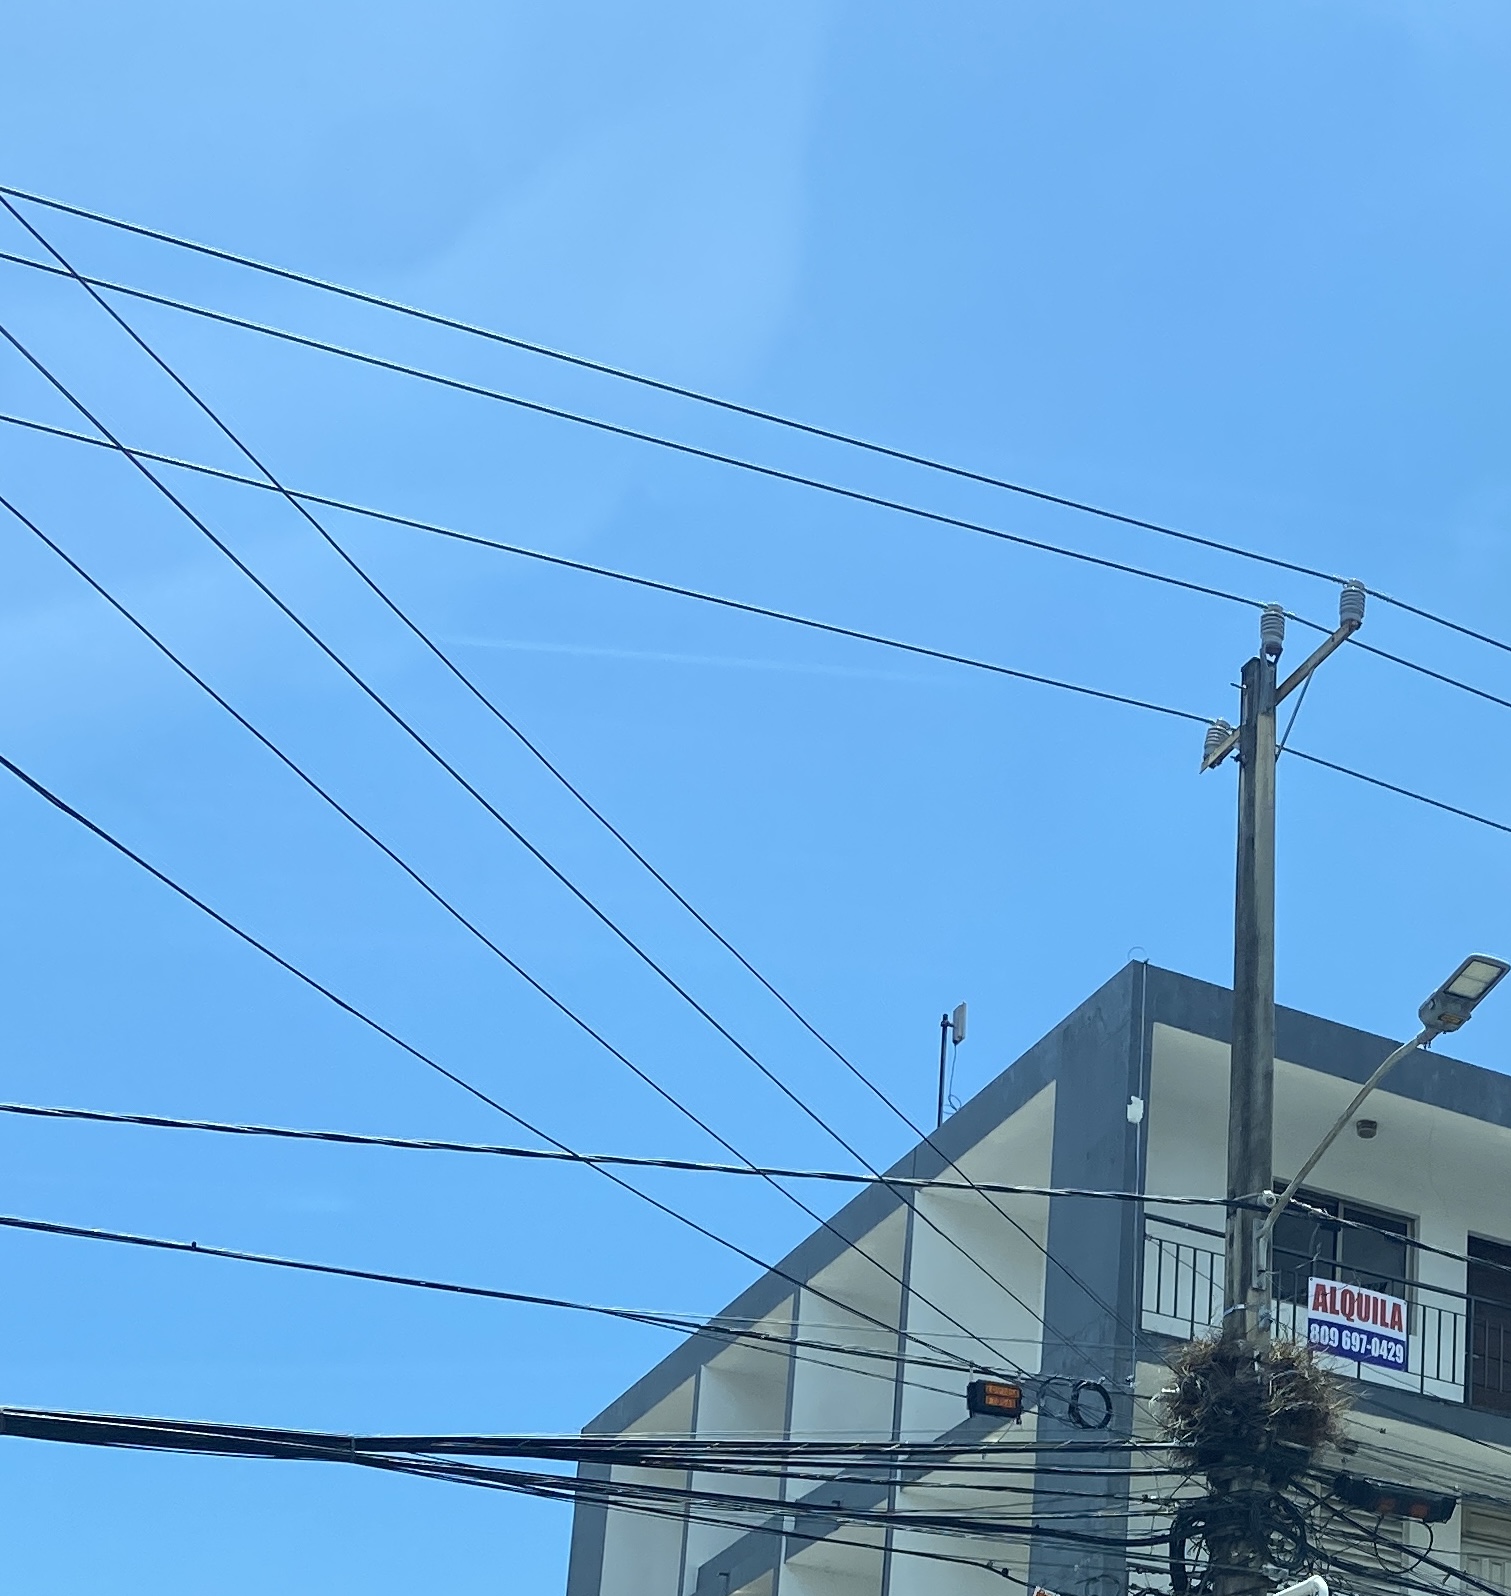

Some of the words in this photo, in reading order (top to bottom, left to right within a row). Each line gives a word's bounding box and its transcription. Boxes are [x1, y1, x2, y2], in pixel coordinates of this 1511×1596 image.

[1311, 1283, 1403, 1333] ALQUILA
[1309, 1323, 1339, 1348] 809
[1341, 1329, 1404, 1363] 697-0429
